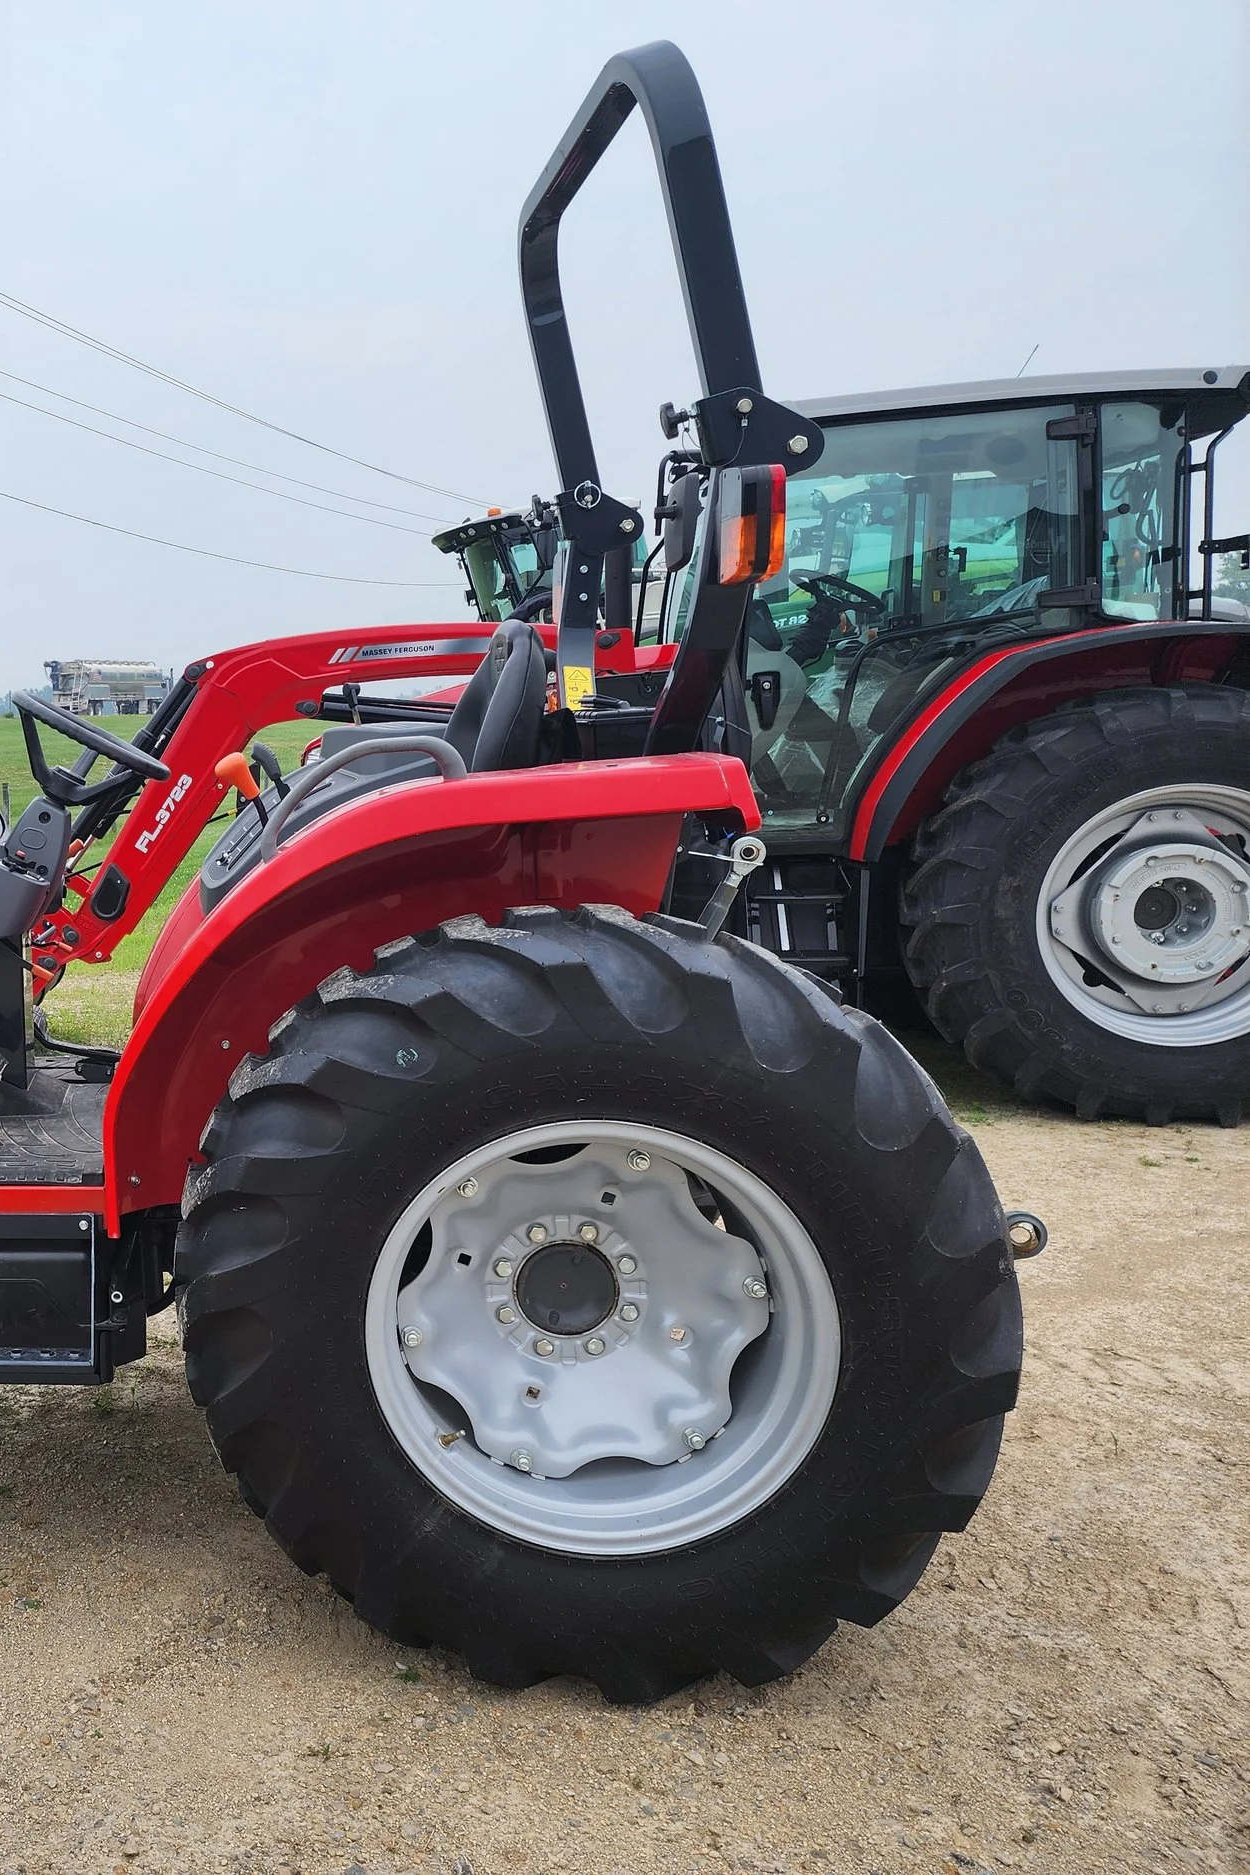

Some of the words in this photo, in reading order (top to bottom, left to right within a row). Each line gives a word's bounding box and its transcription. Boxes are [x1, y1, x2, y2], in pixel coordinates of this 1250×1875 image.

[362, 648, 393, 657] MASSEY
[394, 645, 435, 654] FERGUSON
[134, 774, 192, 853] FL.3723
